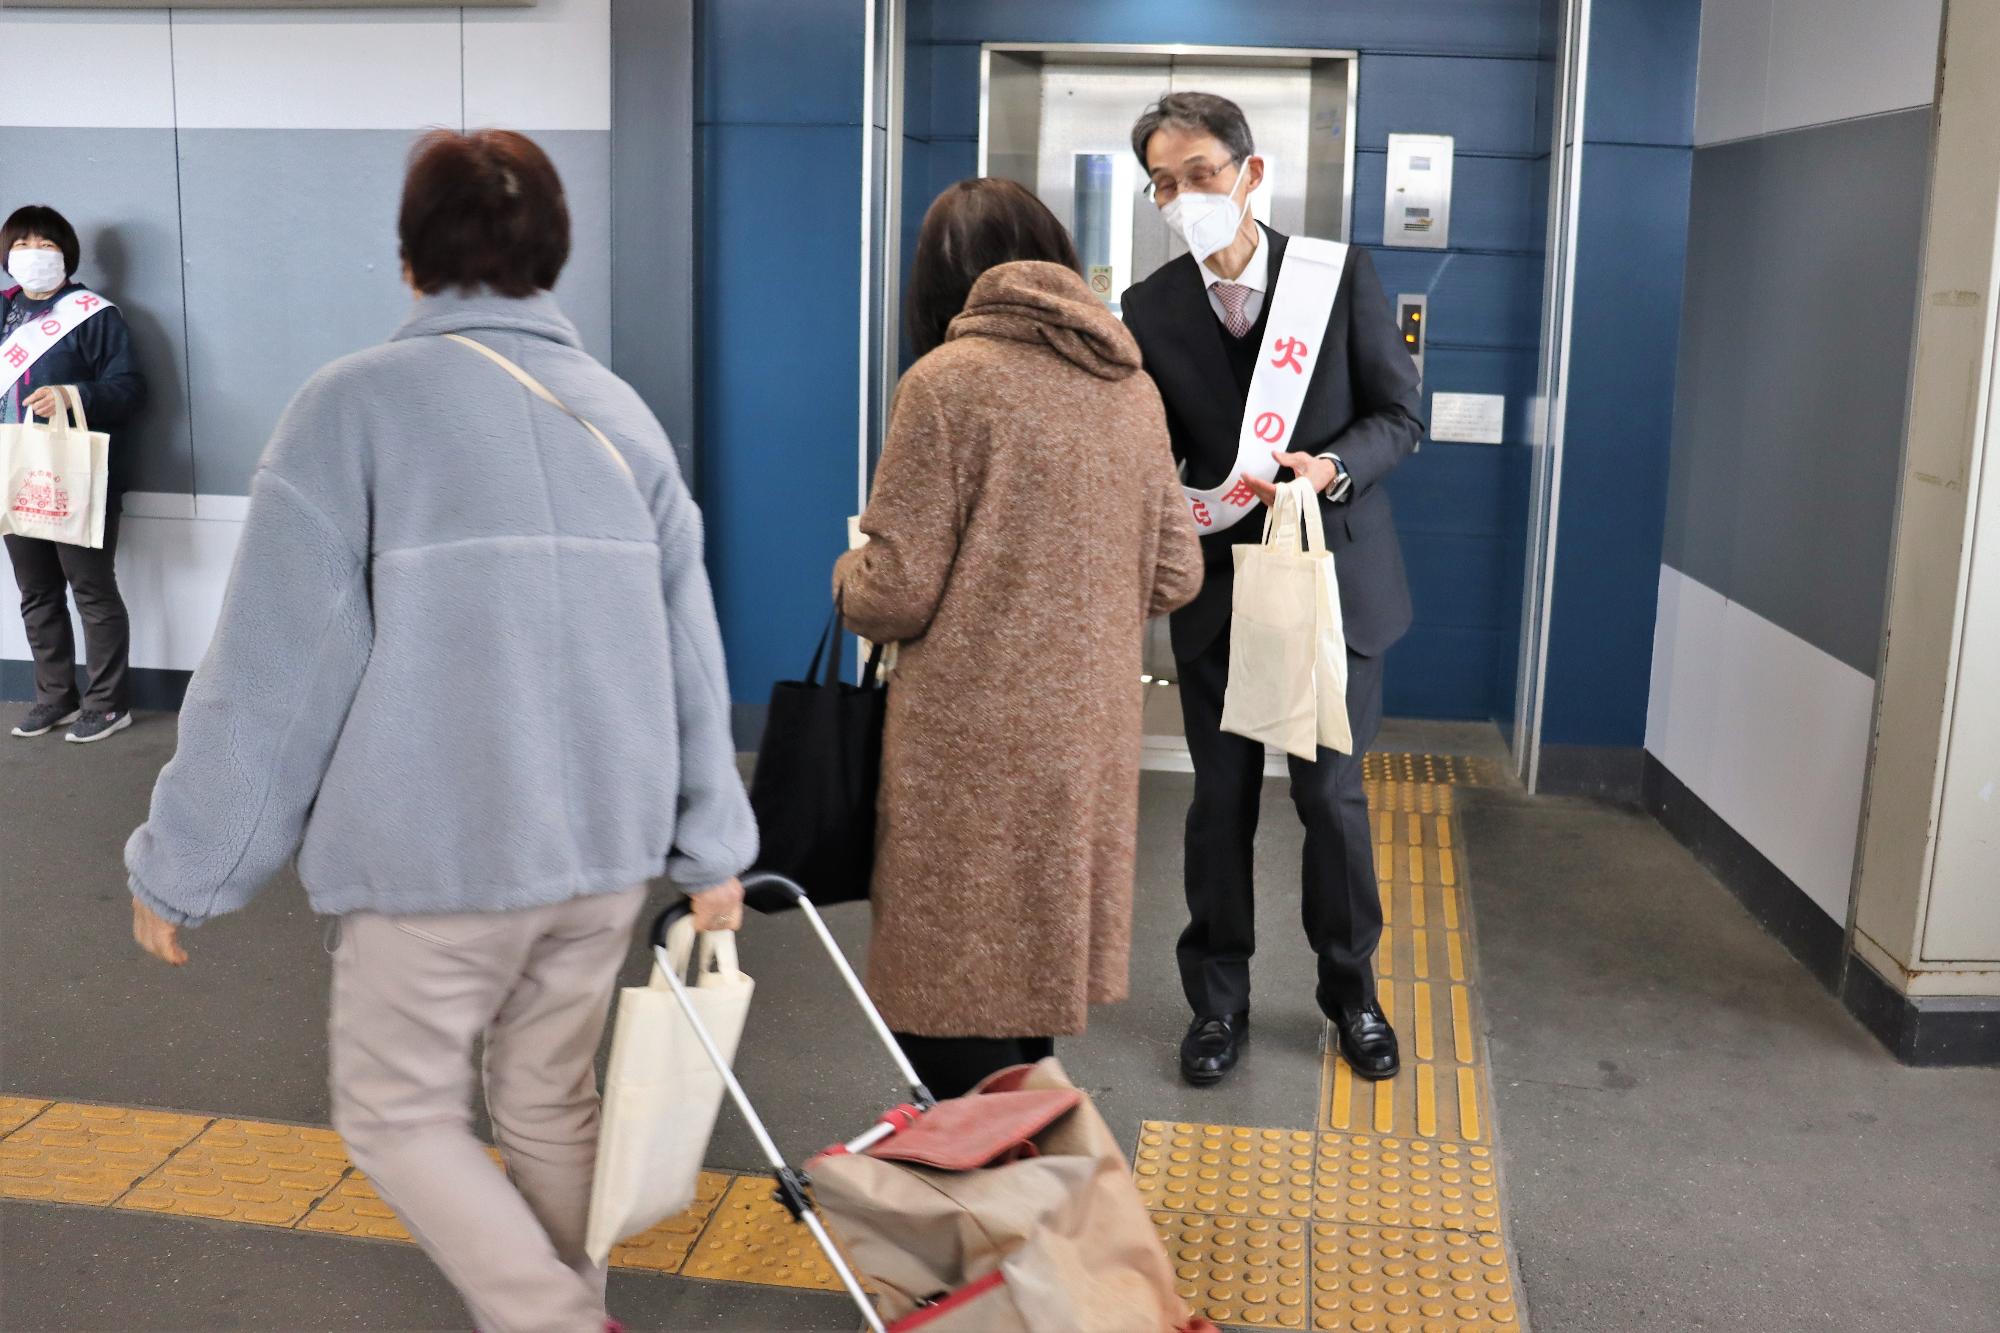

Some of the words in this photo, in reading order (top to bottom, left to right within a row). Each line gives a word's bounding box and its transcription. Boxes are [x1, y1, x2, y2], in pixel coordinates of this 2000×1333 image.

[4, 293, 100, 368] 火の用
[1190, 336, 1308, 527] 火の用心
